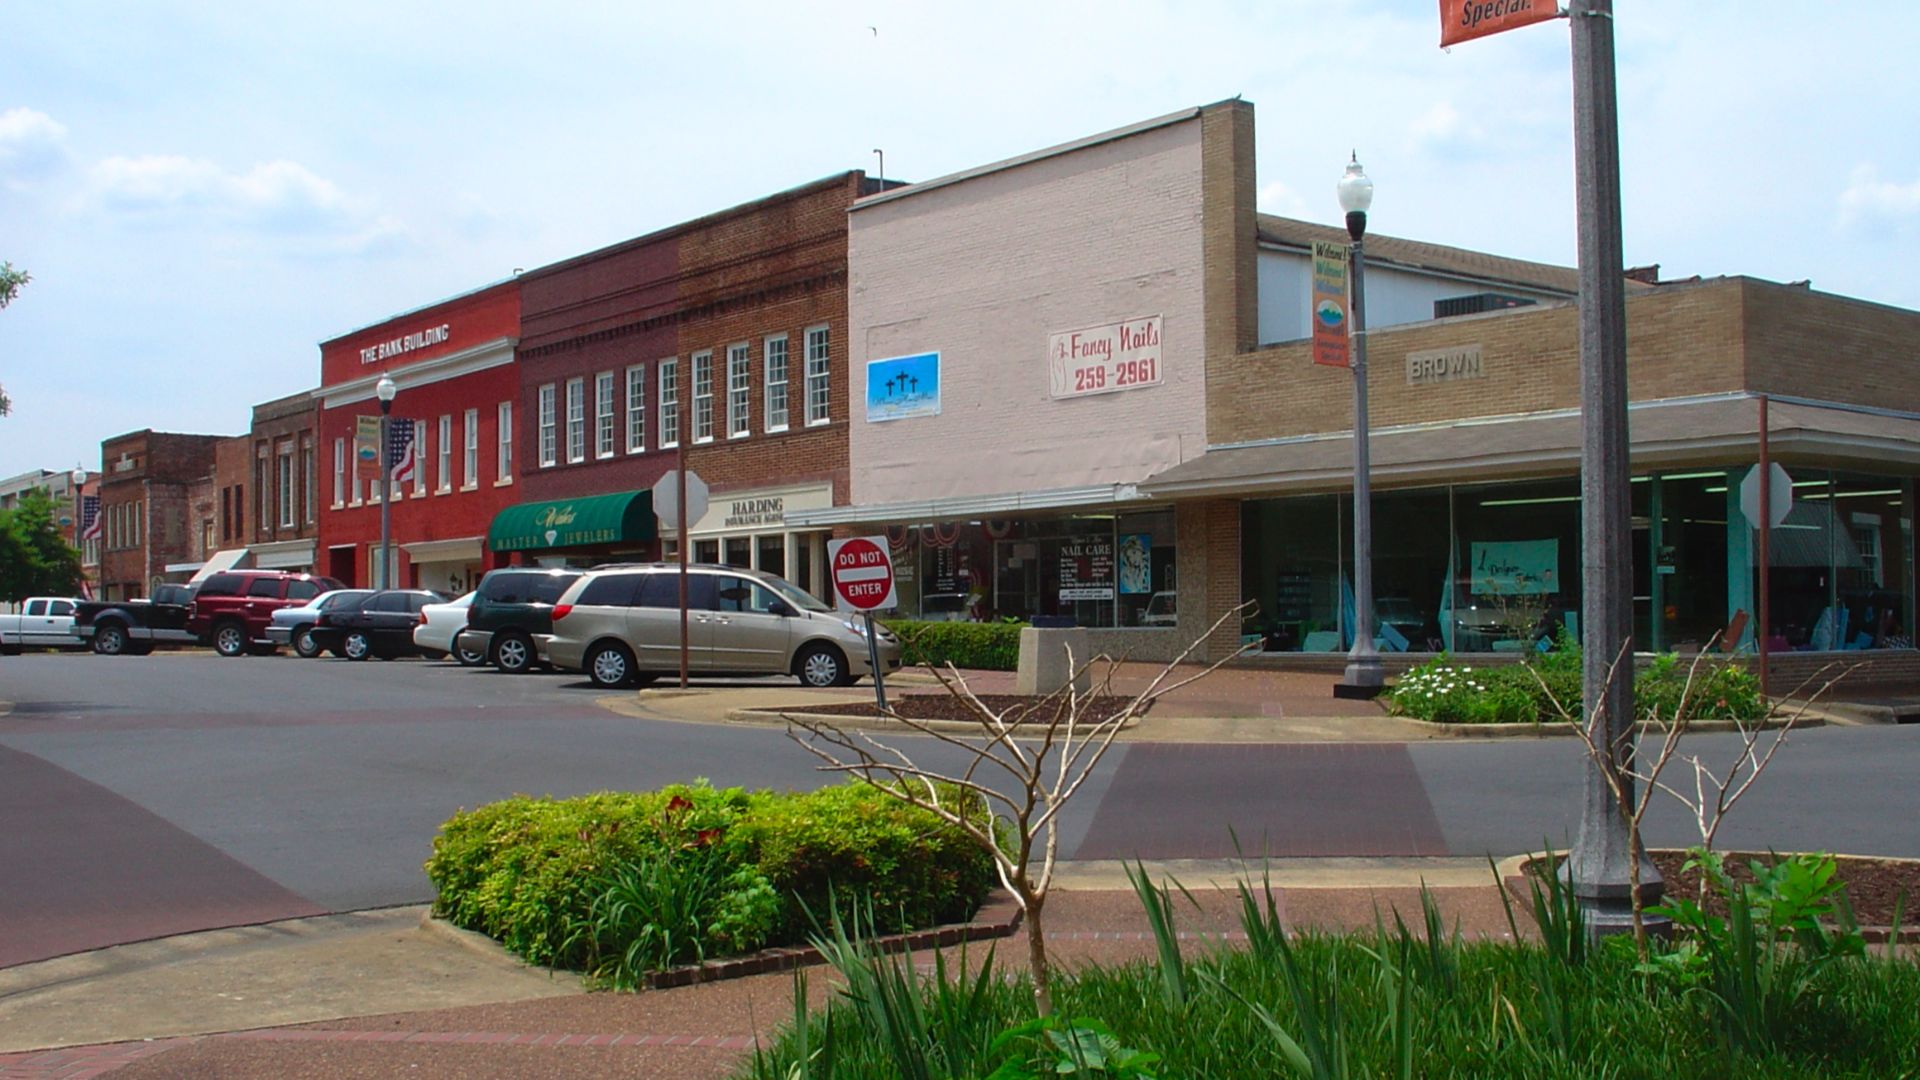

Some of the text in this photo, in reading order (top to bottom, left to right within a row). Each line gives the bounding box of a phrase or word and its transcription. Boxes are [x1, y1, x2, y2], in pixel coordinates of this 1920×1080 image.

[360, 324, 449, 364] THE BANK BUILDING
[1071, 321, 1159, 361] Fancy Nails
[1075, 358, 1155, 391] 259-2961
[1410, 351, 1479, 379] BROWN
[732, 498, 783, 515] HARDING
[497, 529, 615, 550] MASTER JEWELERS
[1061, 544, 1111, 556] NAIL CARE
[840, 553, 855, 565] DO
[860, 551, 880, 563] NOT
[848, 583, 882, 596] ENTER
